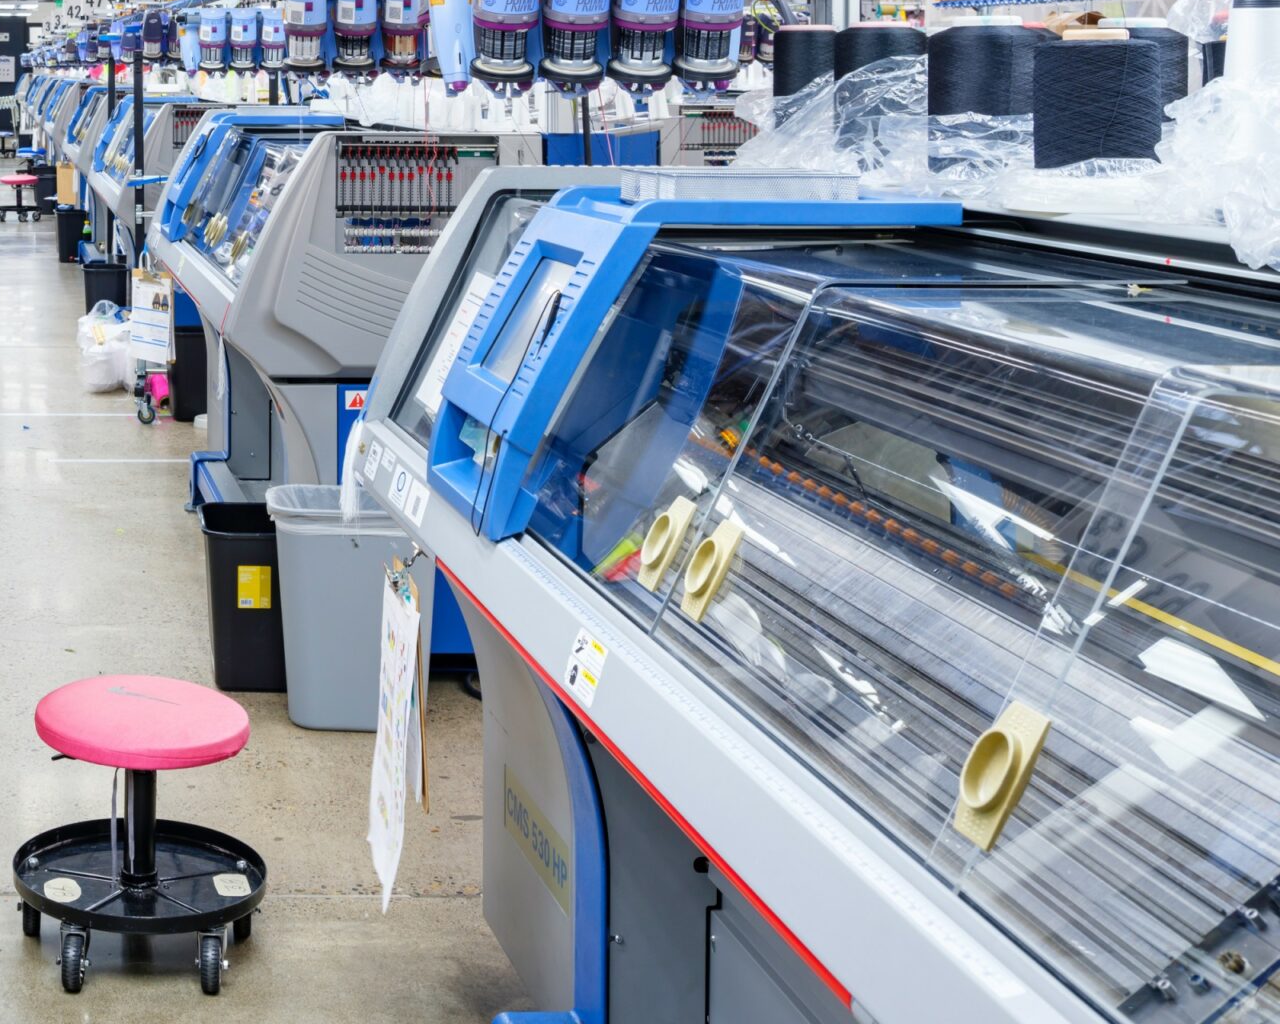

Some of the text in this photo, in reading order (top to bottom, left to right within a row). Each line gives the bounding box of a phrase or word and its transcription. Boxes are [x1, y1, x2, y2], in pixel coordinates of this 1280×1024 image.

[66, 5, 81, 19] 42
[507, 787, 567, 888] CMS 530 HP
